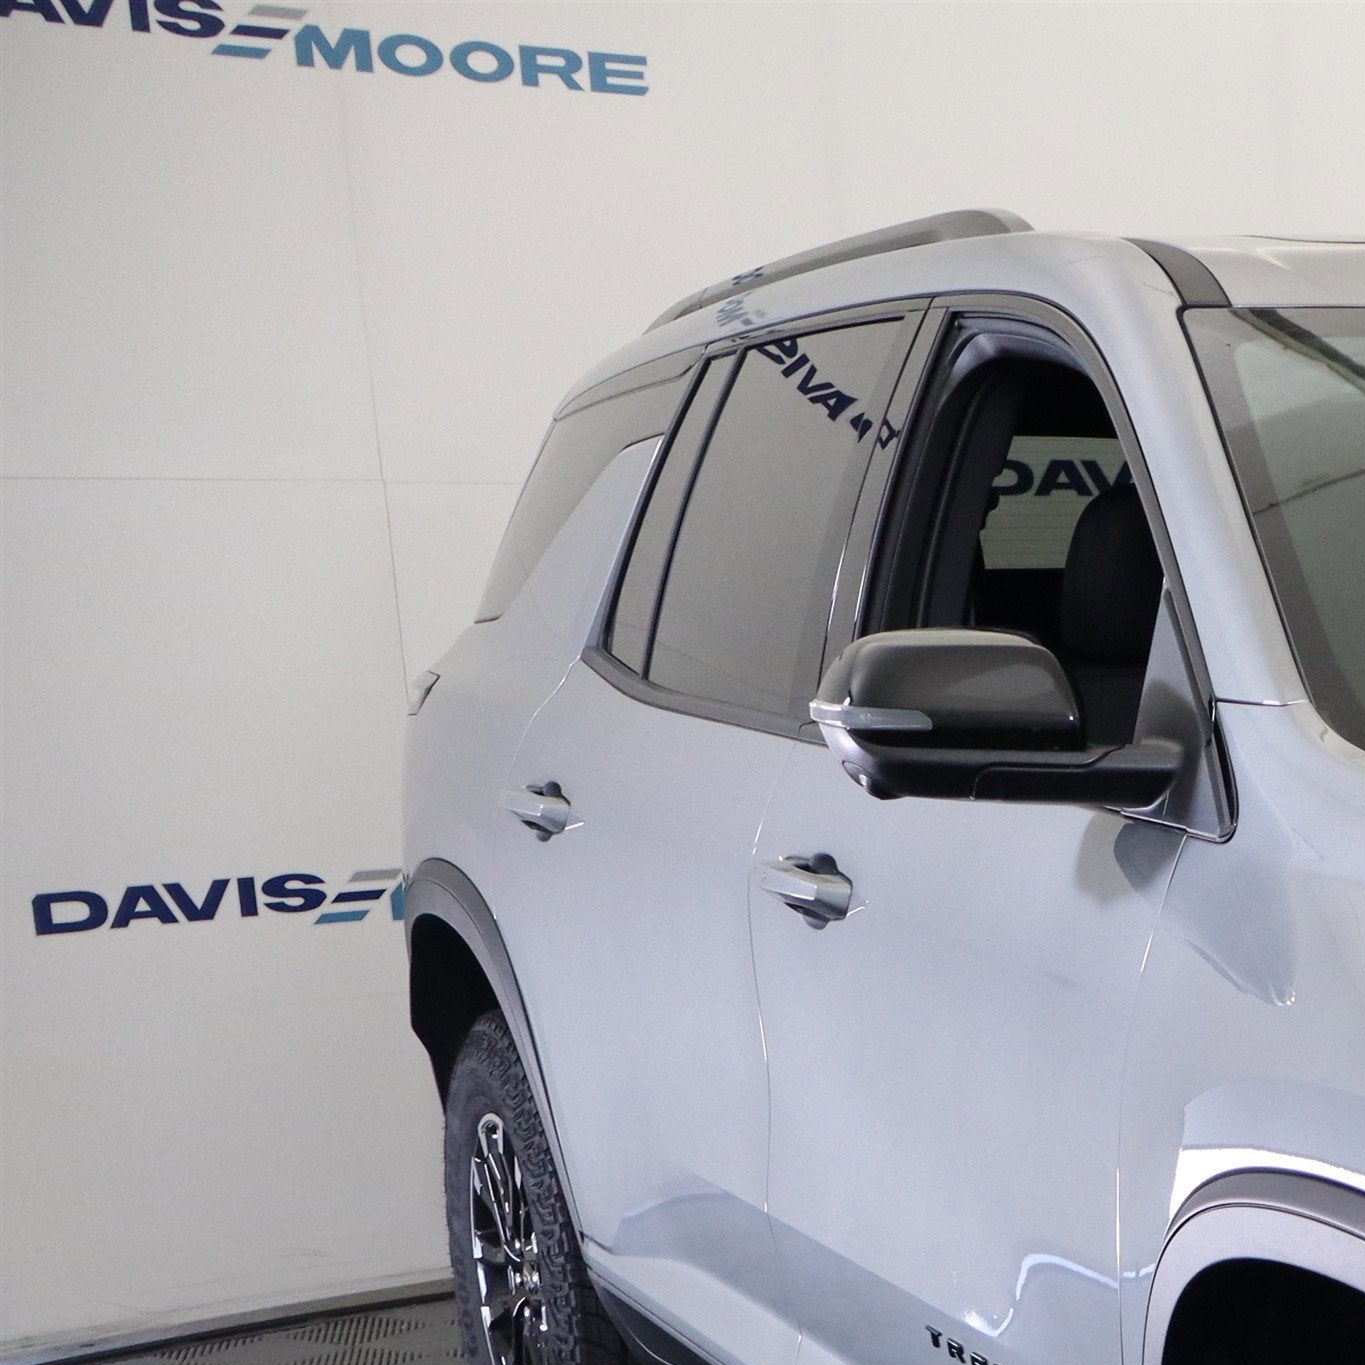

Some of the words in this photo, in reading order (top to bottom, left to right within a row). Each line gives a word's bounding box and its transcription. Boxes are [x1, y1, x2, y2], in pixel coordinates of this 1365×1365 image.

[294, 24, 649, 96] MOORE
[991, 459, 1134, 496] DAV
[31, 873, 327, 936] DAVIS
